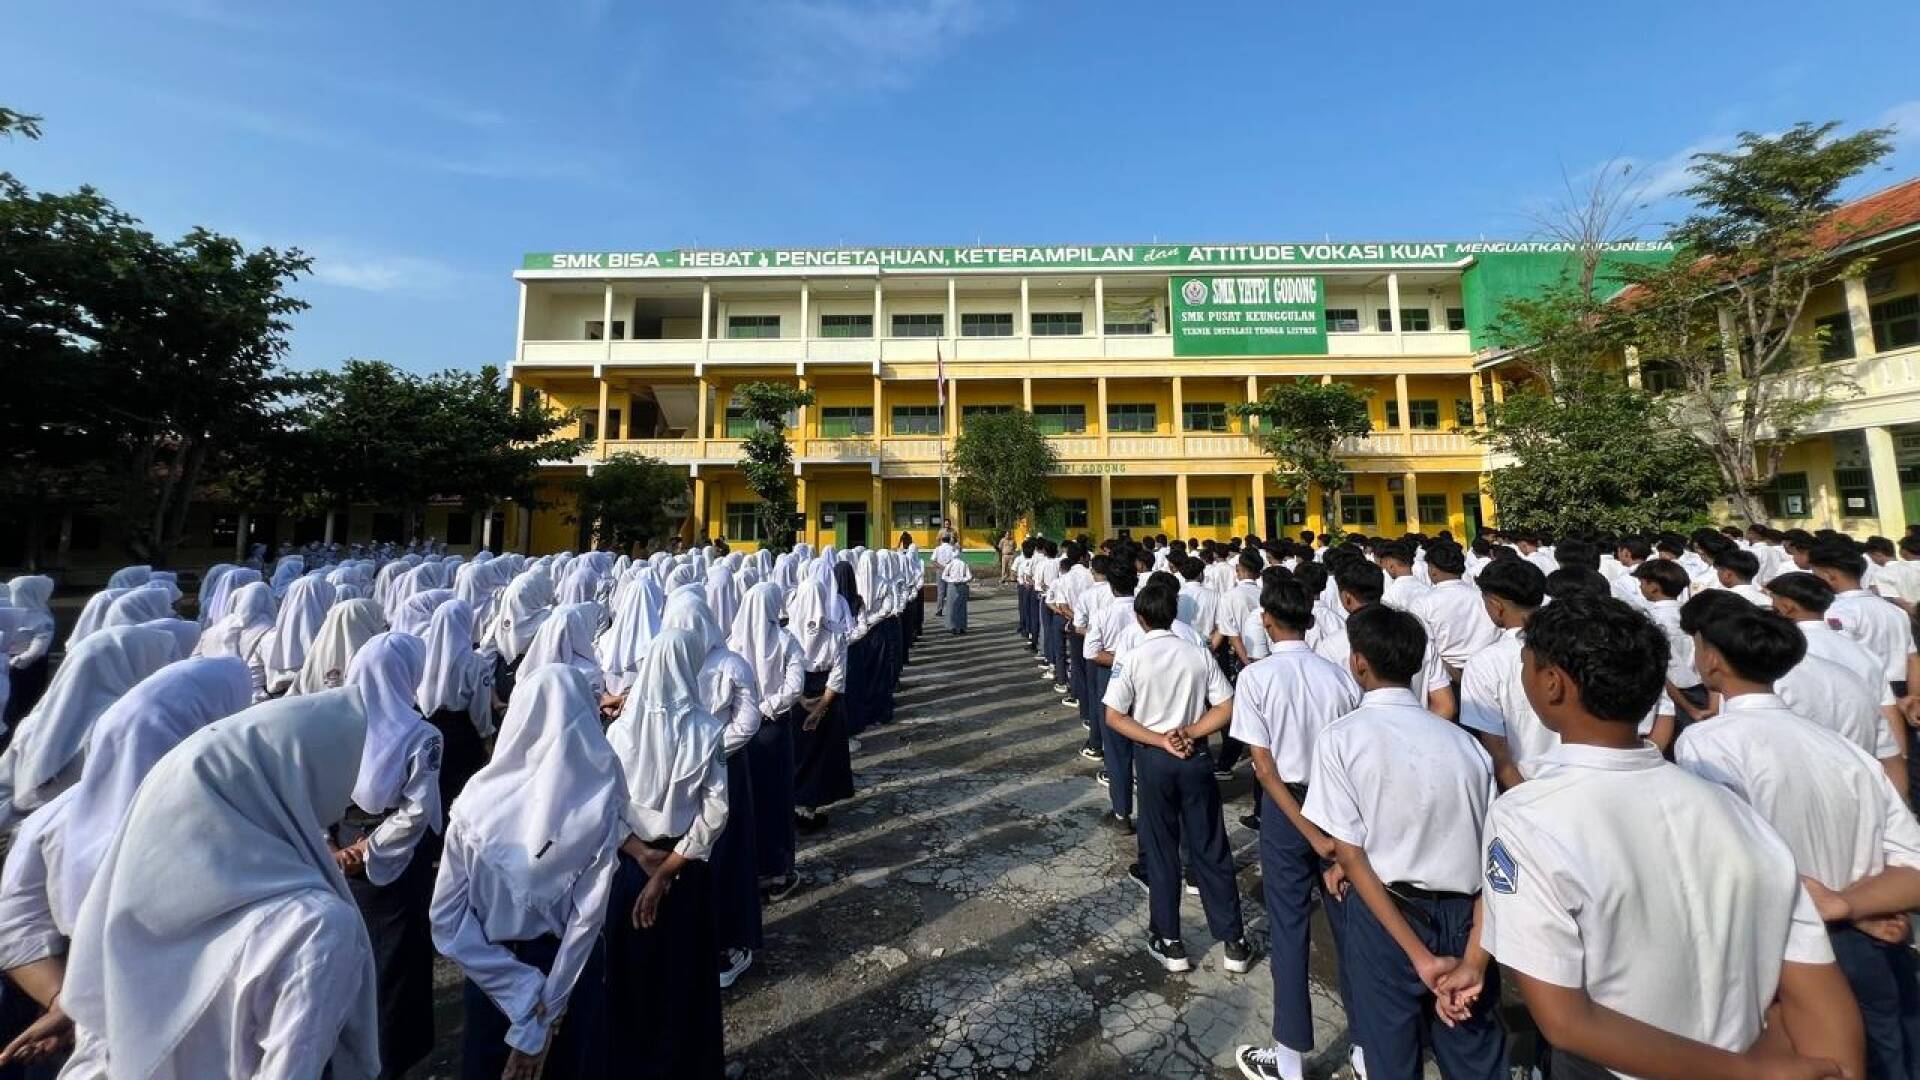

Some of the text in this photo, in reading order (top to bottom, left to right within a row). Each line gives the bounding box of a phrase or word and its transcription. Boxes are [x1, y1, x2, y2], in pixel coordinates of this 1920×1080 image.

[552, 253, 601, 268] SMK
[608, 253, 660, 267] BISA
[680, 251, 755, 267] HEBAT
[776, 249, 949, 266] PENGETAHUAN,
[955, 248, 1133, 264] KETERAMPILAN
[1143, 247, 1179, 262] dan
[1187, 245, 1295, 261] ATTITUDE
[1299, 245, 1384, 260] VOKASI
[1391, 244, 1447, 259] KUAT
[1455, 243, 1576, 253] MENGUATKAN
[1212, 277, 1236, 304] SMK
[1273, 277, 1317, 304] GODONG
[1181, 311, 1315, 321] SMK PUSAT KEUNGGULAN
[1181, 326, 1211, 335] TEKNIK
[1214, 326, 1252, 335] INSTALASI
[1081, 463, 1126, 473] GODONG
